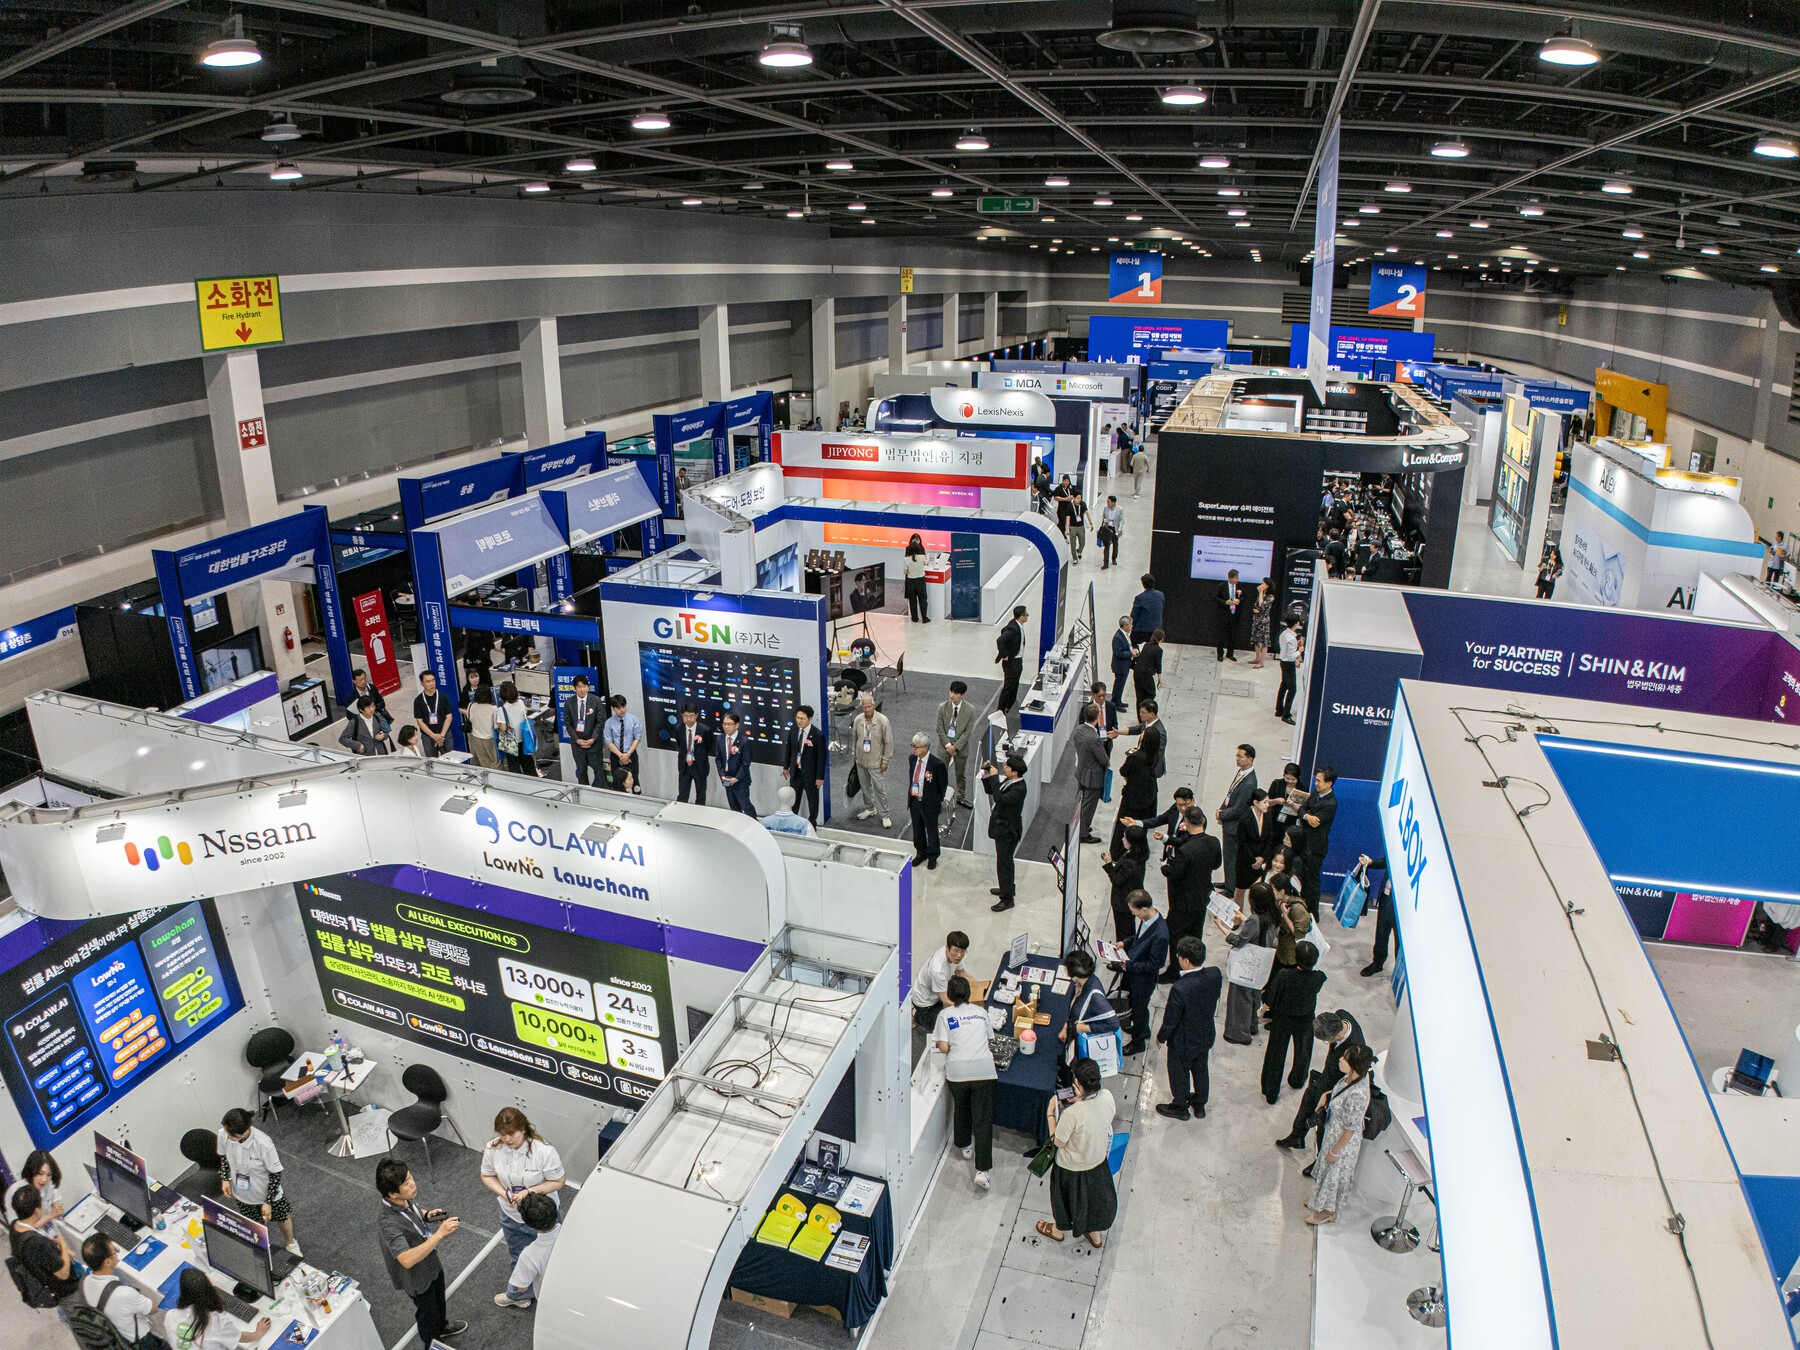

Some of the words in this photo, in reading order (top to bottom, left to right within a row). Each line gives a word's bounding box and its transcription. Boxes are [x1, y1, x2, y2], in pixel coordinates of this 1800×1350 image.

[1116, 257, 1140, 265] 세미나실
[1378, 268, 1403, 277] 세미나실
[206, 279, 273, 309] 소화전
[1138, 272, 1154, 297] 1
[1396, 284, 1417, 311] 2
[236, 311, 261, 320] Hydrant
[1402, 367, 1409, 377] 2
[1069, 381, 1103, 391] Microsoft
[978, 406, 1024, 417] LexisNexis
[241, 420, 263, 437] 소화전
[827, 447, 873, 458] JIPYONG
[958, 451, 983, 466] 지평
[1410, 452, 1463, 466] Law&Company
[754, 486, 765, 501] 보안
[1198, 502, 1239, 511] SuperLawyer
[1240, 504, 1251, 512] 슈퍼
[1252, 505, 1274, 513] 에이전트
[648, 537, 655, 549] 법률
[208, 538, 288, 574] 대한법률구조공단
[556, 578, 563, 590] 법률
[324, 591, 331, 603] 법률
[327, 604, 333, 617] 산업
[62, 628, 74, 637] D14
[503, 617, 540, 632] 로토매틱
[653, 613, 731, 645] GITSN
[734, 631, 781, 650] (주)지슨
[9, 632, 32, 649] 상담존
[432, 632, 440, 646] 법률
[178, 646, 186, 660] 법률
[435, 648, 443, 662] 산업
[1465, 641, 1496, 656] Your
[1497, 644, 1563, 663] PARTNER
[182, 661, 190, 675] 산업
[437, 664, 446, 685] 박람회
[1472, 657, 1491, 669] for
[1493, 658, 1560, 677] SUCCESS
[1578, 653, 1685, 682] SHIN&KIM
[185, 676, 195, 697] 박람회
[1627, 679, 1665, 693] 법무법인(유)
[1666, 682, 1682, 695] 세종
[1780, 695, 1786, 707] 8
[198, 819, 316, 859] Nssam
[507, 820, 644, 867] COLAW.AI
[1398, 780, 1428, 910] LBOX
[240, 854, 263, 866] since
[264, 851, 285, 863] 2002
[553, 865, 650, 901] Lawcham
[151, 916, 195, 948] Lawcham
[310, 908, 349, 930] 대한민국
[348, 916, 370, 937] 1등
[370, 922, 398, 945] 법률
[398, 930, 427, 953] 실무
[426, 938, 470, 966] 플랫폼
[408, 910, 418, 920] AI
[418, 913, 447, 928] LEGAL
[447, 920, 501, 944] EXECUTION
[501, 934, 518, 947] OS
[21, 971, 45, 996] 법률
[45, 964, 65, 983] AI는
[64, 953, 80, 969] 이제
[78, 937, 107, 960] 검색이
[106, 925, 128, 943] 아니라
[316, 930, 346, 954] 법률
[346, 938, 386, 967] 실무의
[385, 957, 406, 972] 모든
[405, 961, 422, 978] 것,
[421, 961, 454, 986] 코로
[453, 975, 488, 996] 하나로
[329, 961, 353, 975] 상담부터
[381, 976, 406, 992] 소송까지
[406, 981, 427, 996] 하나의
[428, 989, 435, 998] AI
[505, 965, 585, 1000] 13,000+
[610, 976, 631, 988] since
[631, 982, 653, 993] 2002
[347, 997, 385, 1015] COLAW.AI
[607, 992, 636, 1014] 24
[636, 1003, 648, 1017] 년
[25, 998, 69, 1031] COLAW.AI
[518, 1009, 598, 1044] 10,000+
[488, 1042, 534, 1064] Lawcham
[622, 1039, 636, 1056] 3
[637, 1048, 648, 1059] 초
